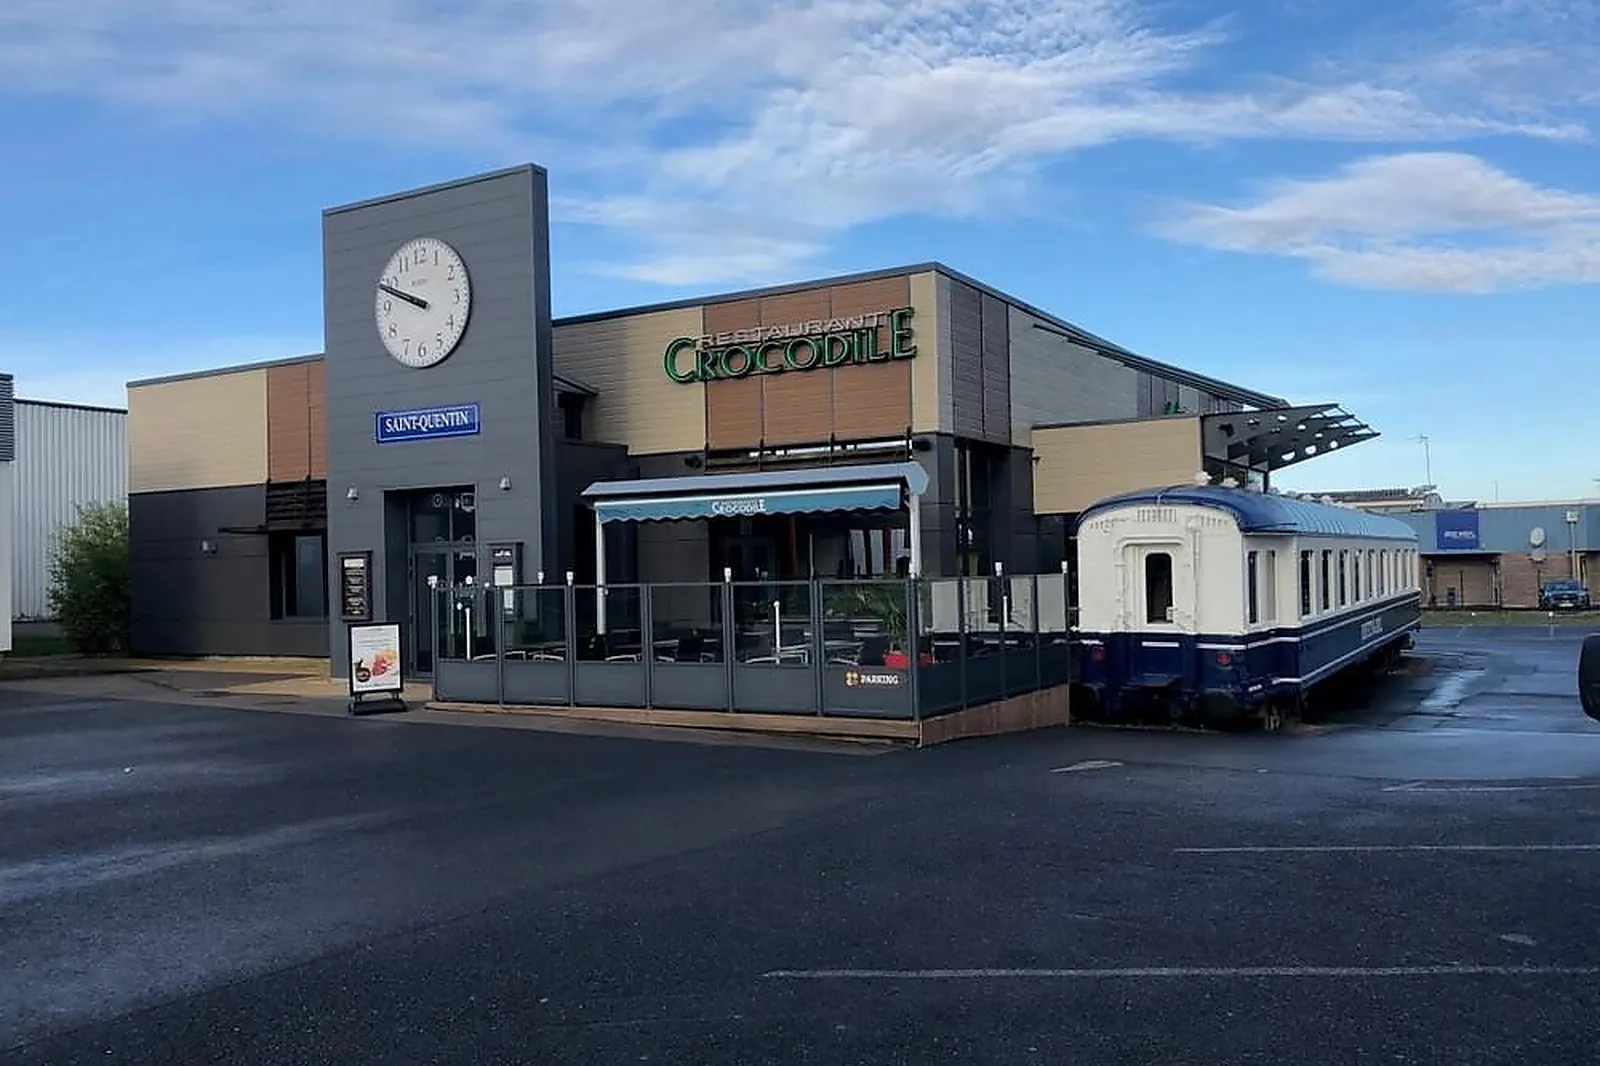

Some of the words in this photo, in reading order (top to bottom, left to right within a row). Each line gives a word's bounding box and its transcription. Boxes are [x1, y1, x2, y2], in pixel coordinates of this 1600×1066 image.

[398, 257, 409, 273] 11
[413, 248, 427, 265] 12
[433, 250, 438, 266] 1
[447, 265, 455, 281] 2
[453, 288, 461, 305] 3
[383, 300, 391, 317] 9
[388, 323, 397, 339] 8
[445, 314, 454, 331] 4
[695, 311, 888, 348] RESTAURANT
[402, 338, 410, 356] 7
[418, 341, 427, 358] 6
[435, 332, 443, 350] 5
[664, 307, 918, 384] CROCODILE
[384, 410, 469, 433] SAINT-QUENTIN
[859, 674, 899, 685] PARKING
